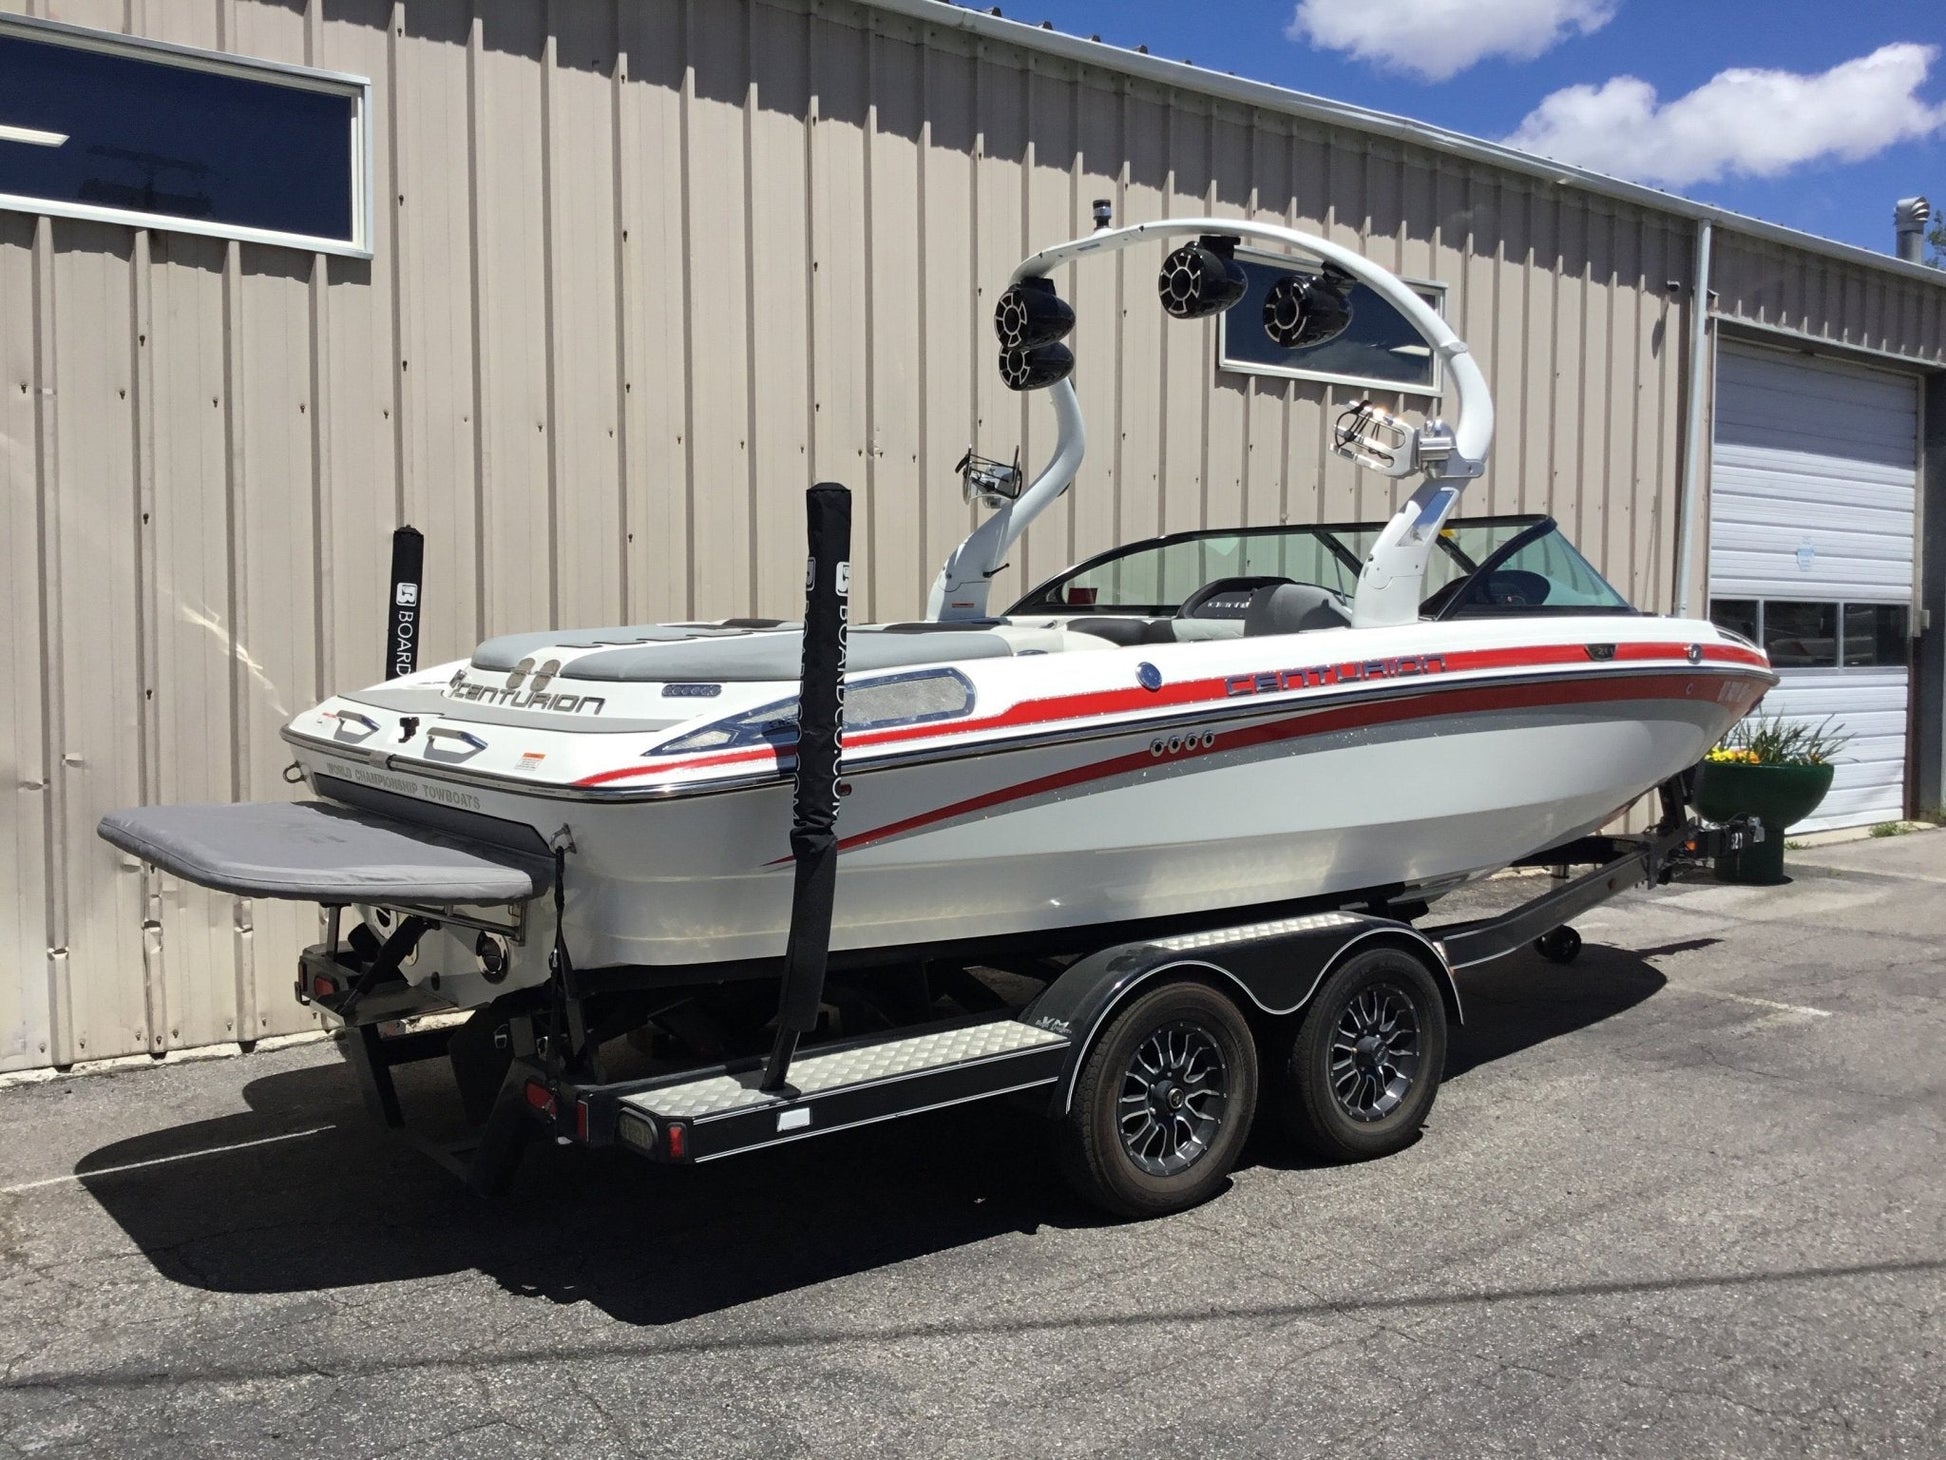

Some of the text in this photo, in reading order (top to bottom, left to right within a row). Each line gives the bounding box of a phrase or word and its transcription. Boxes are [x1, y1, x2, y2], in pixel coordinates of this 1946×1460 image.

[396, 611, 414, 676] BOARD
[1225, 653, 1445, 696] CENTURION
[454, 682, 606, 716] CENTURION
[326, 762, 481, 811] WORLD CHAMPIONSHIP TOWBOATS
